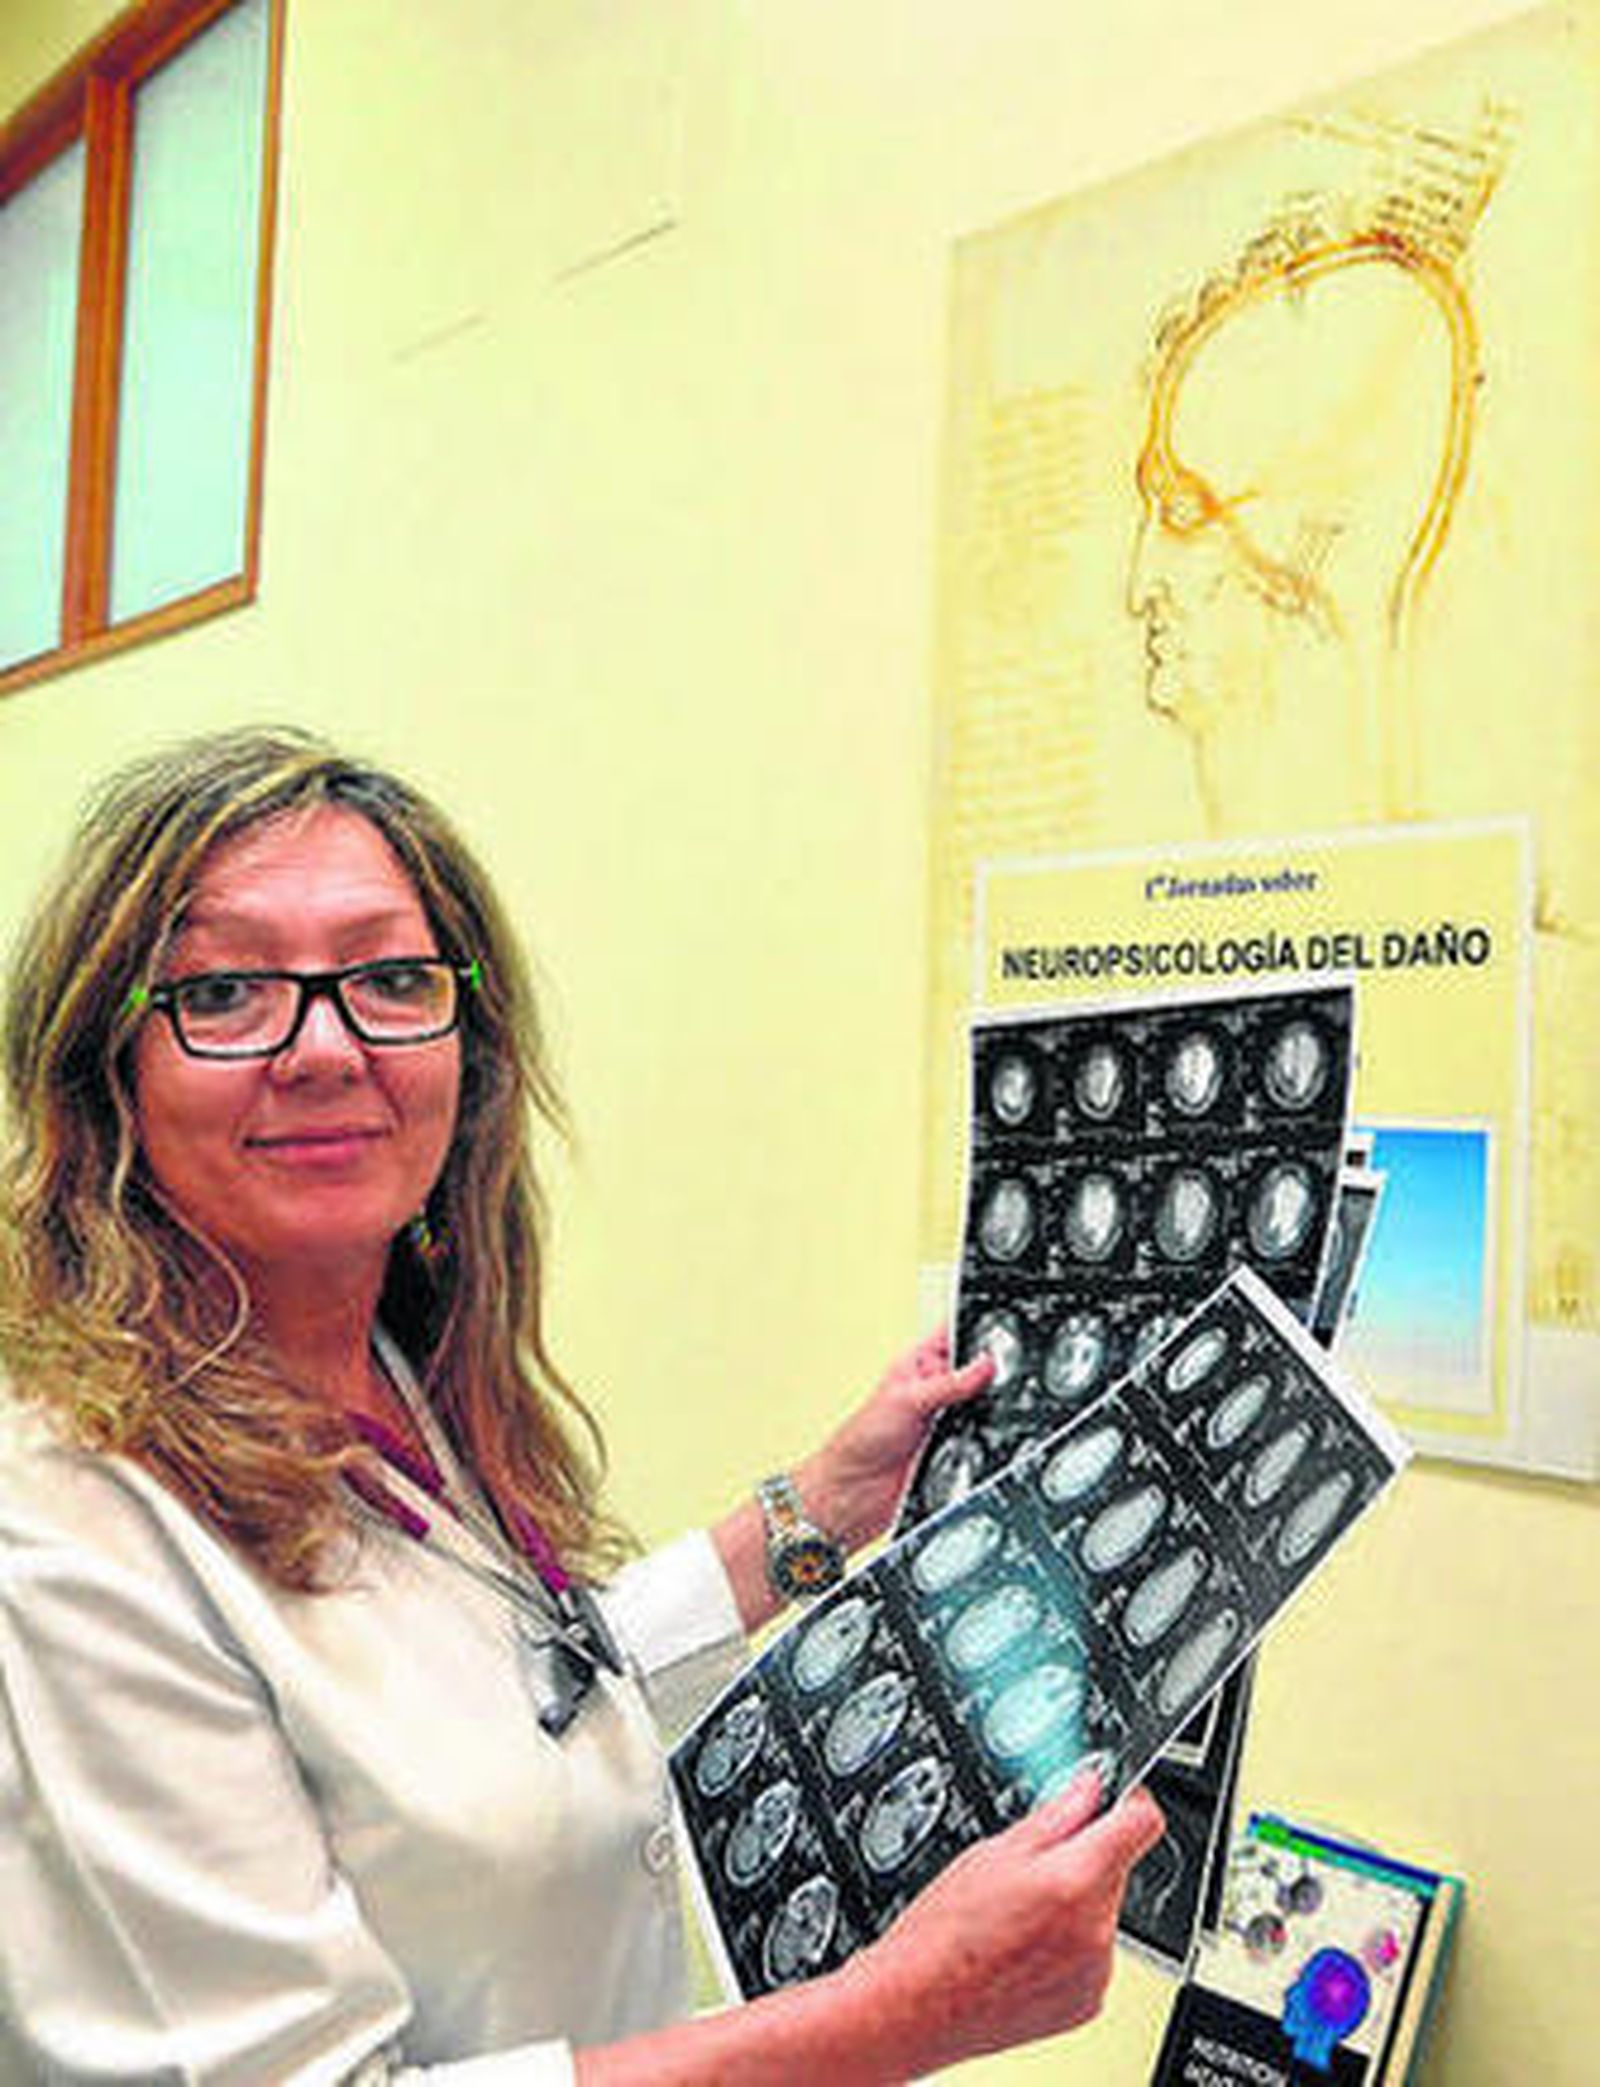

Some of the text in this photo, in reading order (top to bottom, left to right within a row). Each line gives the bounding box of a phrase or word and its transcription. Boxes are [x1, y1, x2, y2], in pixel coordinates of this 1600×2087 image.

[1002, 922, 1491, 979] NEUROPSICOLOGÍA DEL DAÑO
